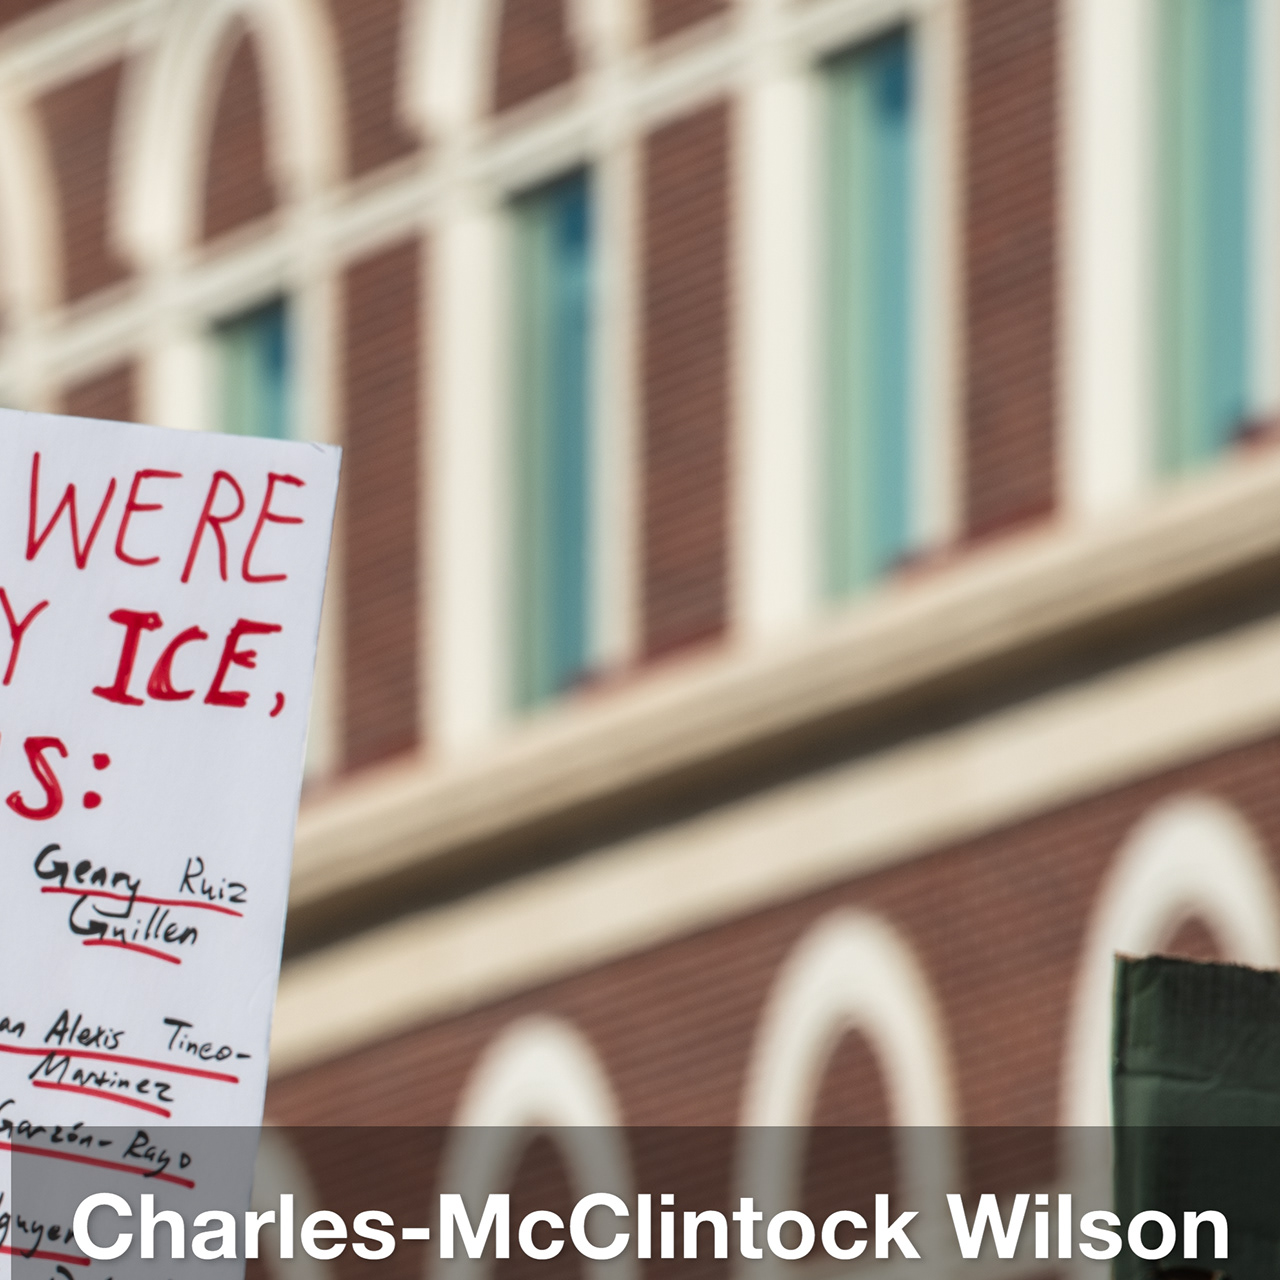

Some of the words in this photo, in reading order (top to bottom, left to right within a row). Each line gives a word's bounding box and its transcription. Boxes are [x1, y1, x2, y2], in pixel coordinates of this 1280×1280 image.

[26, 451, 307, 584] WERE
[92, 608, 287, 718] ICE,
[179, 856, 249, 904] Ruiz
[44, 1009, 126, 1050] Alexis
[28, 1051, 175, 1103] Martinez
